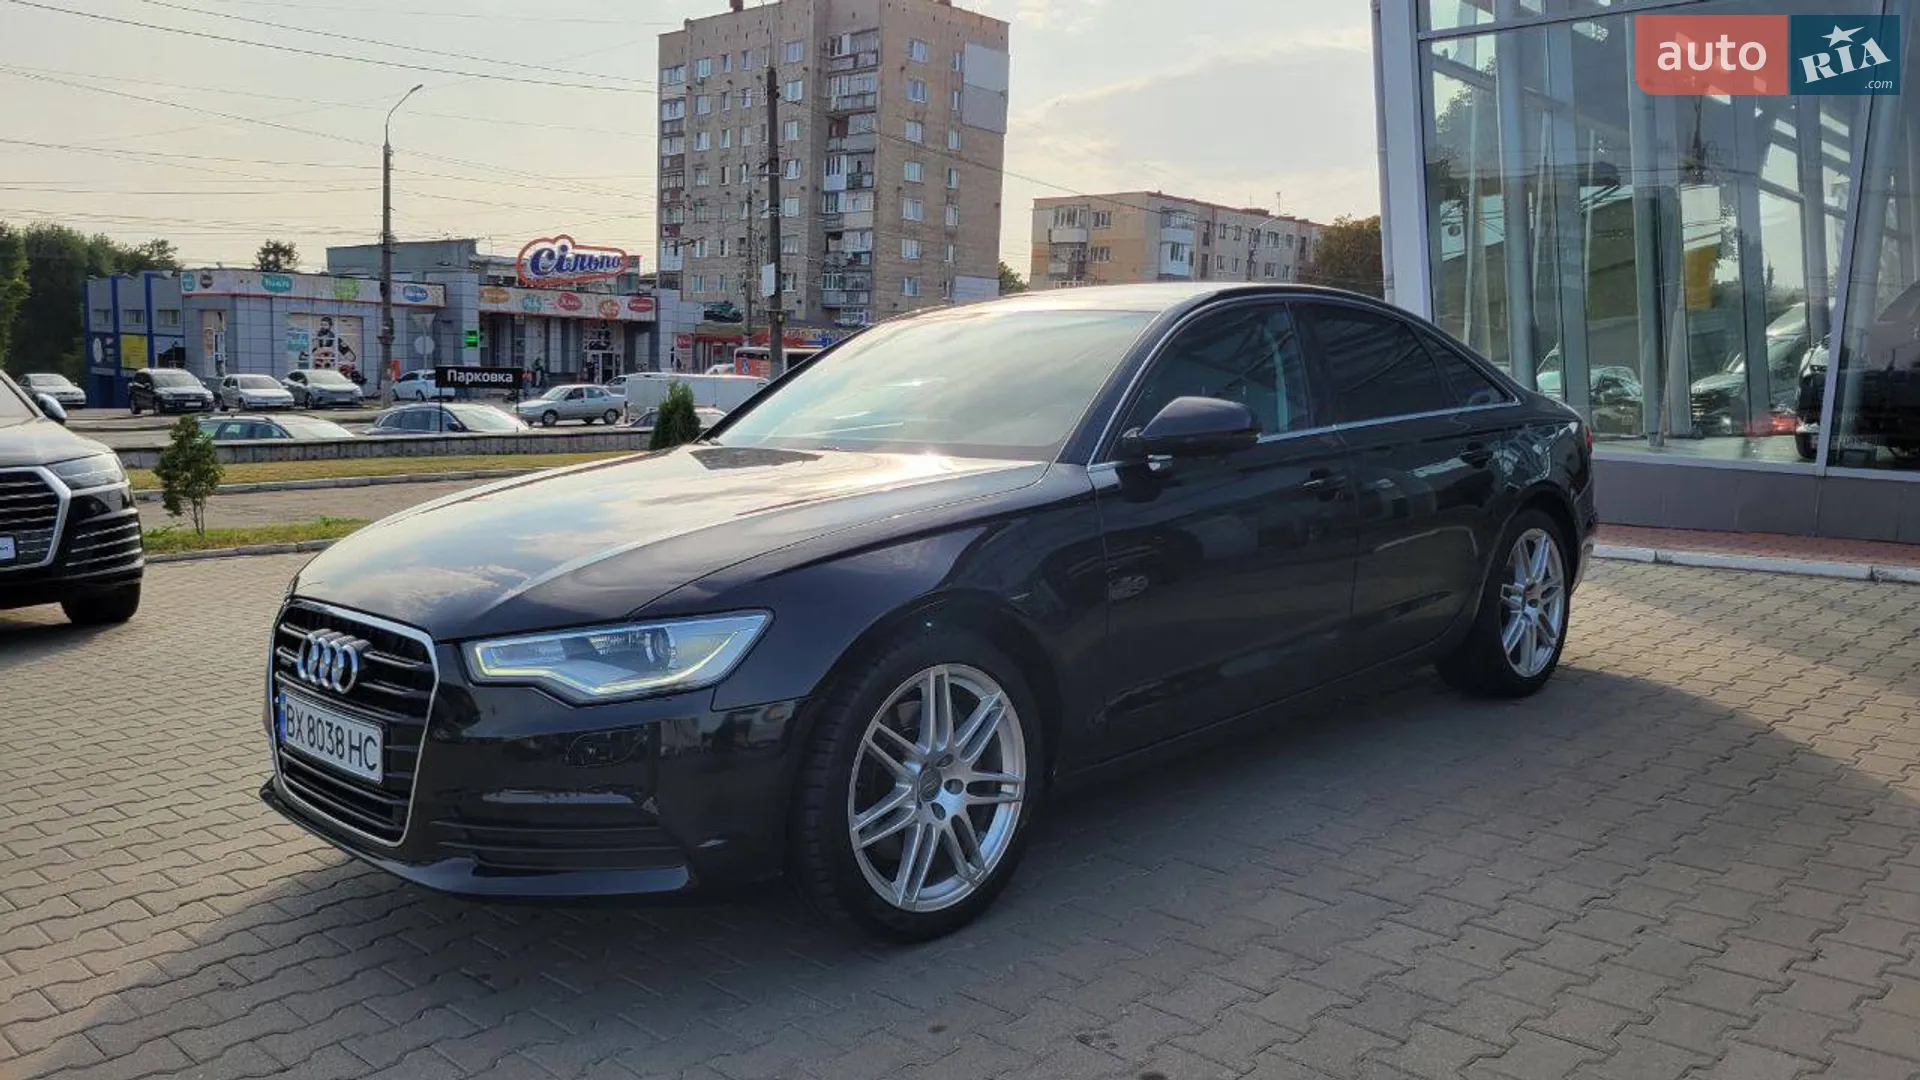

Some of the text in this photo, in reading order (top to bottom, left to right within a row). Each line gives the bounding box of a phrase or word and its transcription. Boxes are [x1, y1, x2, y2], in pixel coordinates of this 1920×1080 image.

[530, 244, 621, 276] Сільпо
[447, 369, 513, 384] Парковка
[286, 703, 377, 771] BX 8038 HC
